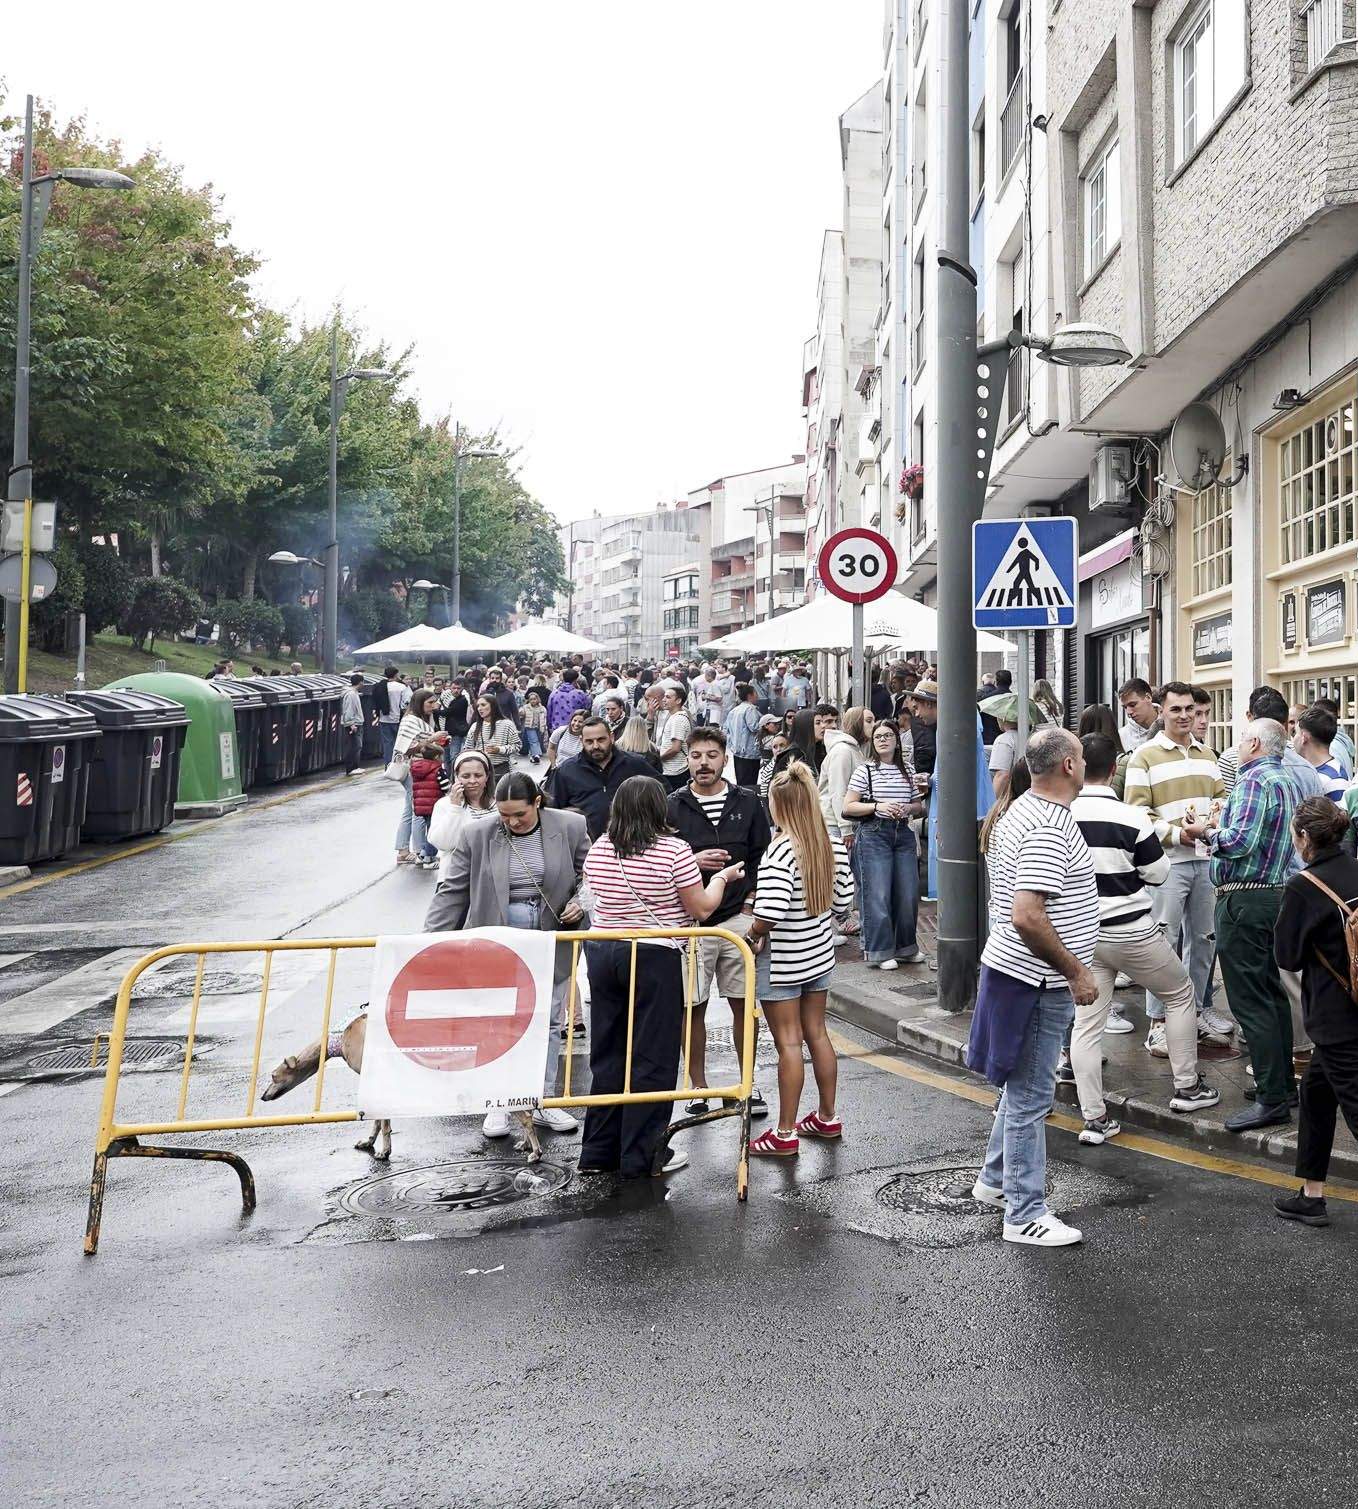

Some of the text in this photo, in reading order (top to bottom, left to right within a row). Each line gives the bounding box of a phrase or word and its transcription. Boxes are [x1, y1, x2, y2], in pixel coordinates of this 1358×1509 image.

[839, 554, 879, 577] 30
[485, 1100, 494, 1108] P.
[496, 1099, 505, 1107] L.
